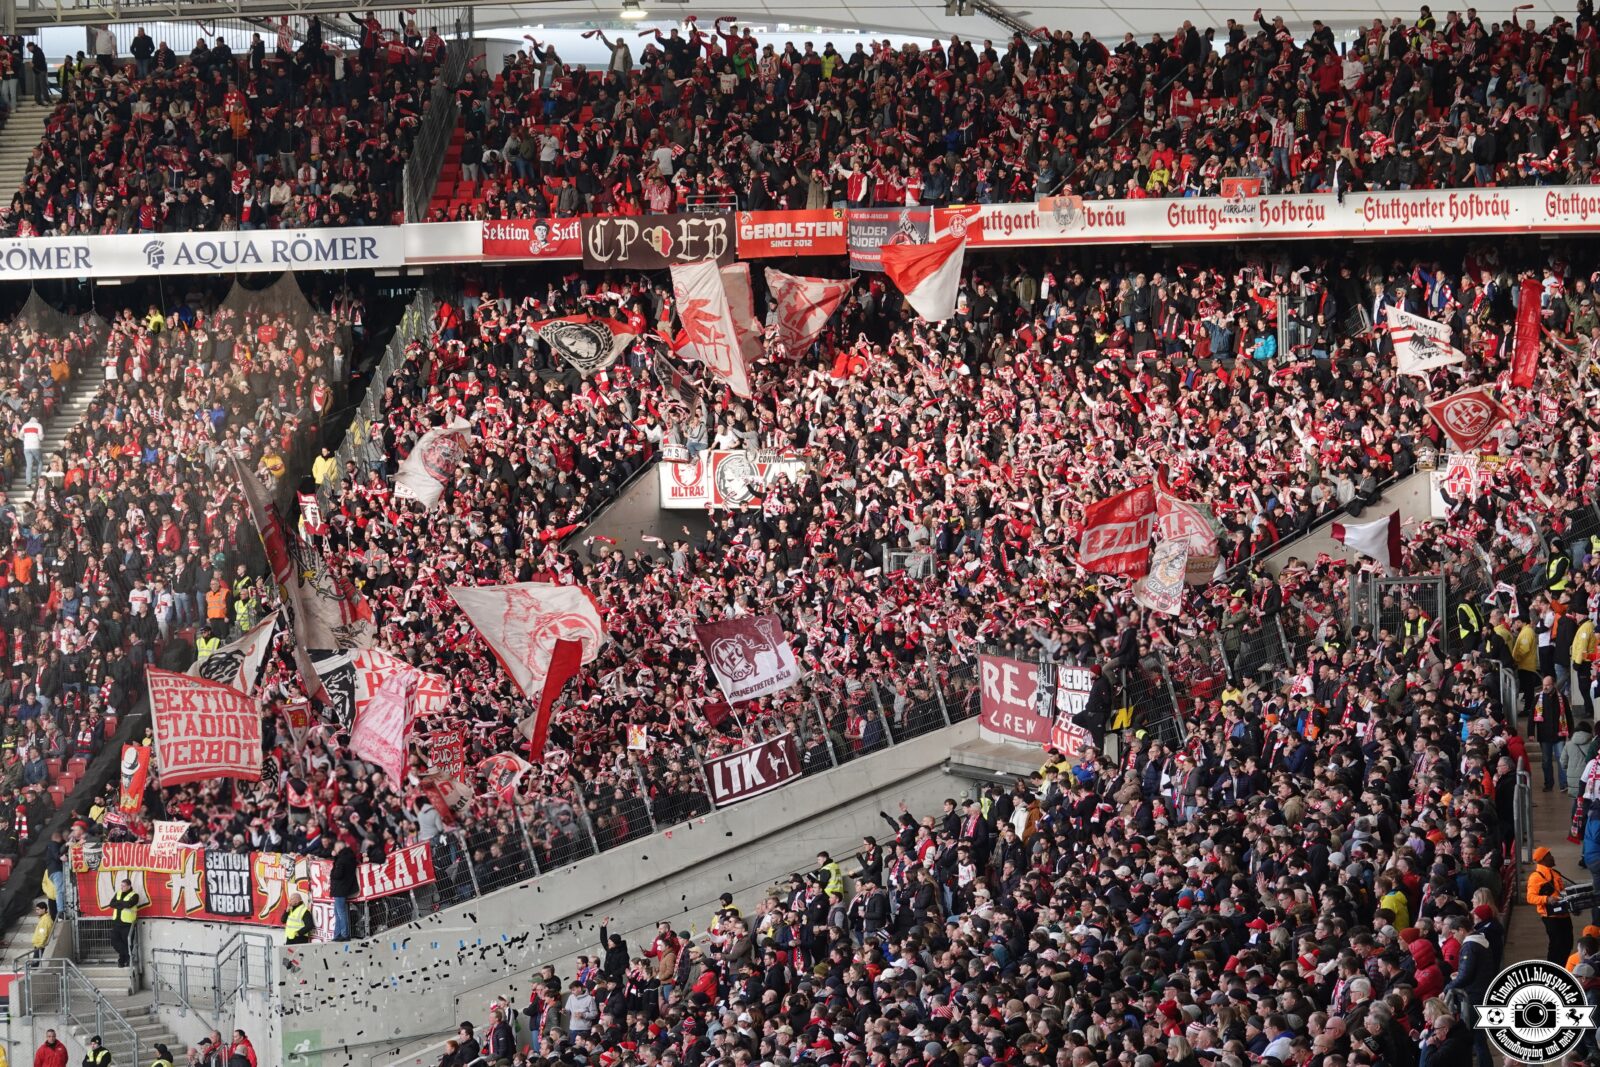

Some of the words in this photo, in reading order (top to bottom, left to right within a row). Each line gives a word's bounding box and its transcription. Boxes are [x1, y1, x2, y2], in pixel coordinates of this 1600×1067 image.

[983, 209, 1040, 236] uttgart
[1081, 206, 1126, 231] fbräu
[1259, 198, 1325, 228] Hofbräu
[1363, 195, 1447, 226] Stuttgarter
[1448, 191, 1511, 222] Hofbräu
[483, 222, 530, 241] Sektion
[551, 219, 580, 241] Suff
[588, 217, 640, 263] CP
[741, 221, 844, 241] GEROLSTEIN
[851, 225, 888, 236] WILDER
[173, 239, 263, 270] AQUA
[271, 233, 380, 263] RÖMER
[770, 239, 792, 248] SINCE
[793, 239, 813, 248] 2012
[671, 485, 705, 498] ULTRAS
[152, 688, 257, 714] SEKTION
[156, 713, 260, 741] STADION
[990, 710, 1037, 735] CREW
[160, 739, 260, 769] VERBOT
[712, 748, 766, 799] LTK
[206, 853, 249, 871] SEKTION
[206, 871, 250, 896] STADT
[208, 895, 250, 913] VERBOT
